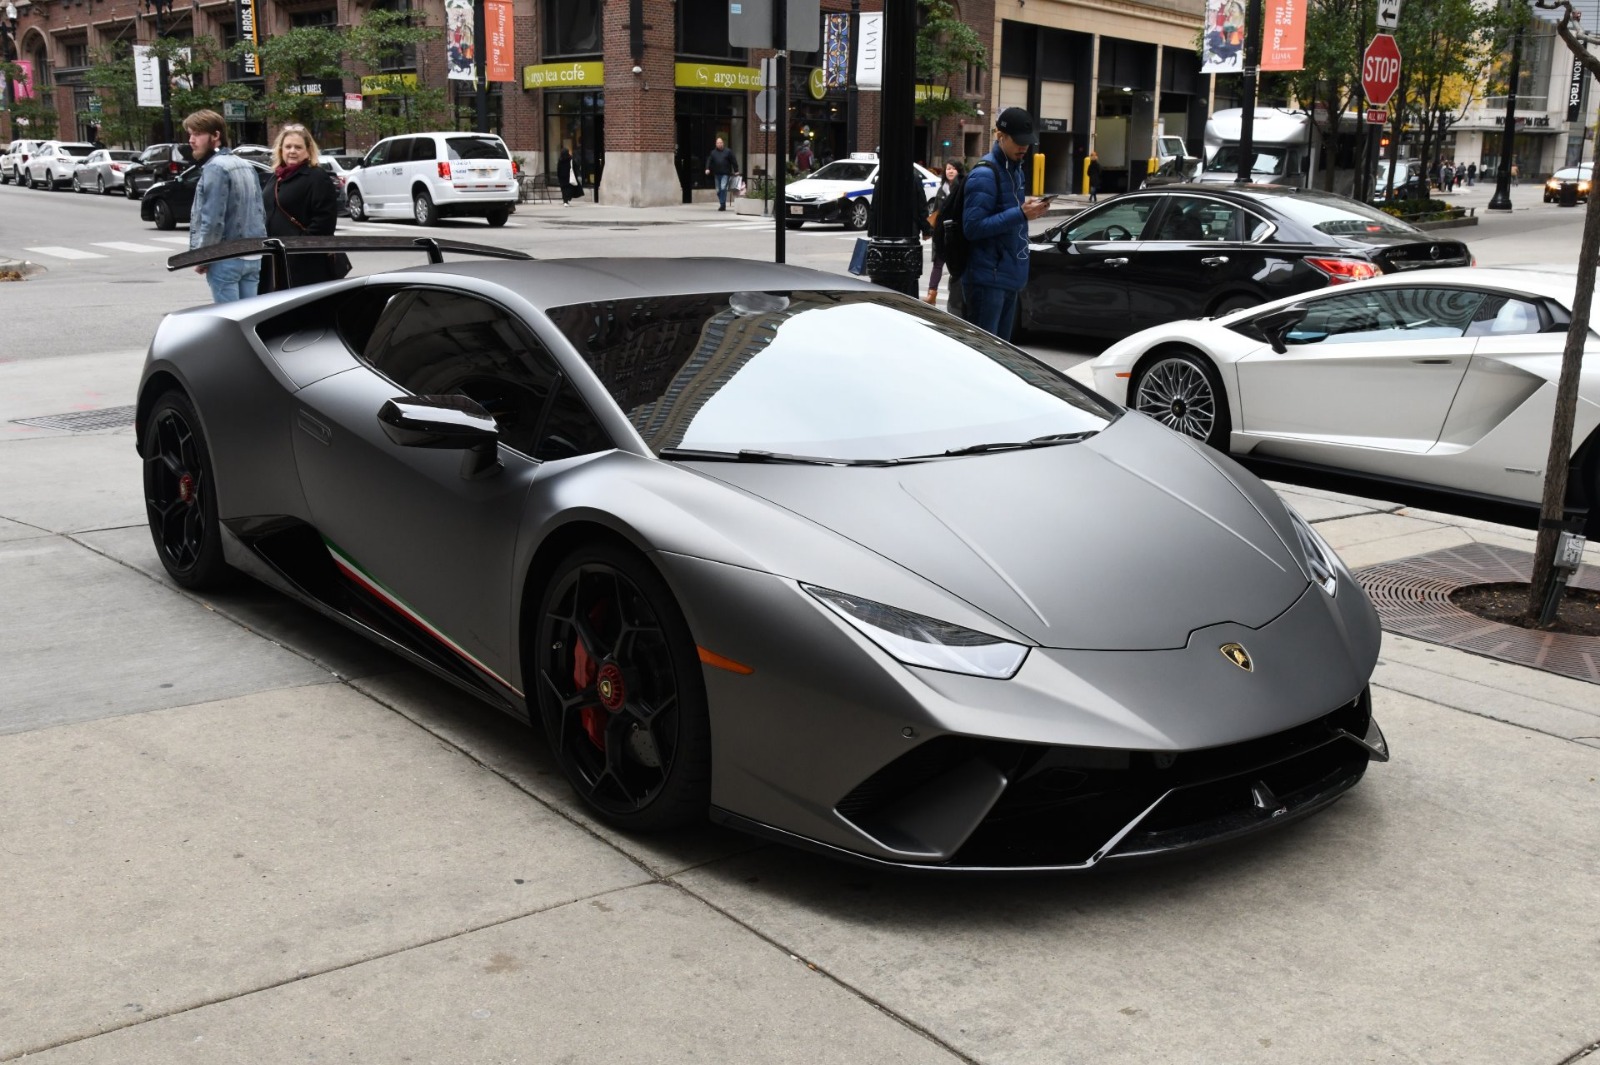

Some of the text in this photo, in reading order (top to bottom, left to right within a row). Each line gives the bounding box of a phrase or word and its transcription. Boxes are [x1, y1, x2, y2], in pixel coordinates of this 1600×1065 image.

[498, 4, 506, 48] Following
[1273, 7, 1285, 50] the Box
[243, 33, 256, 73] EINSN
[864, 18, 878, 70] LUMA
[545, 70, 558, 81] tea
[560, 64, 585, 80] café
[714, 72, 736, 87] argo
[738, 72, 749, 85] tea
[1365, 56, 1398, 83] STOP
[1570, 83, 1580, 106] rack
[1368, 112, 1385, 121] ALL WAY
[1534, 115, 1550, 127] rack
